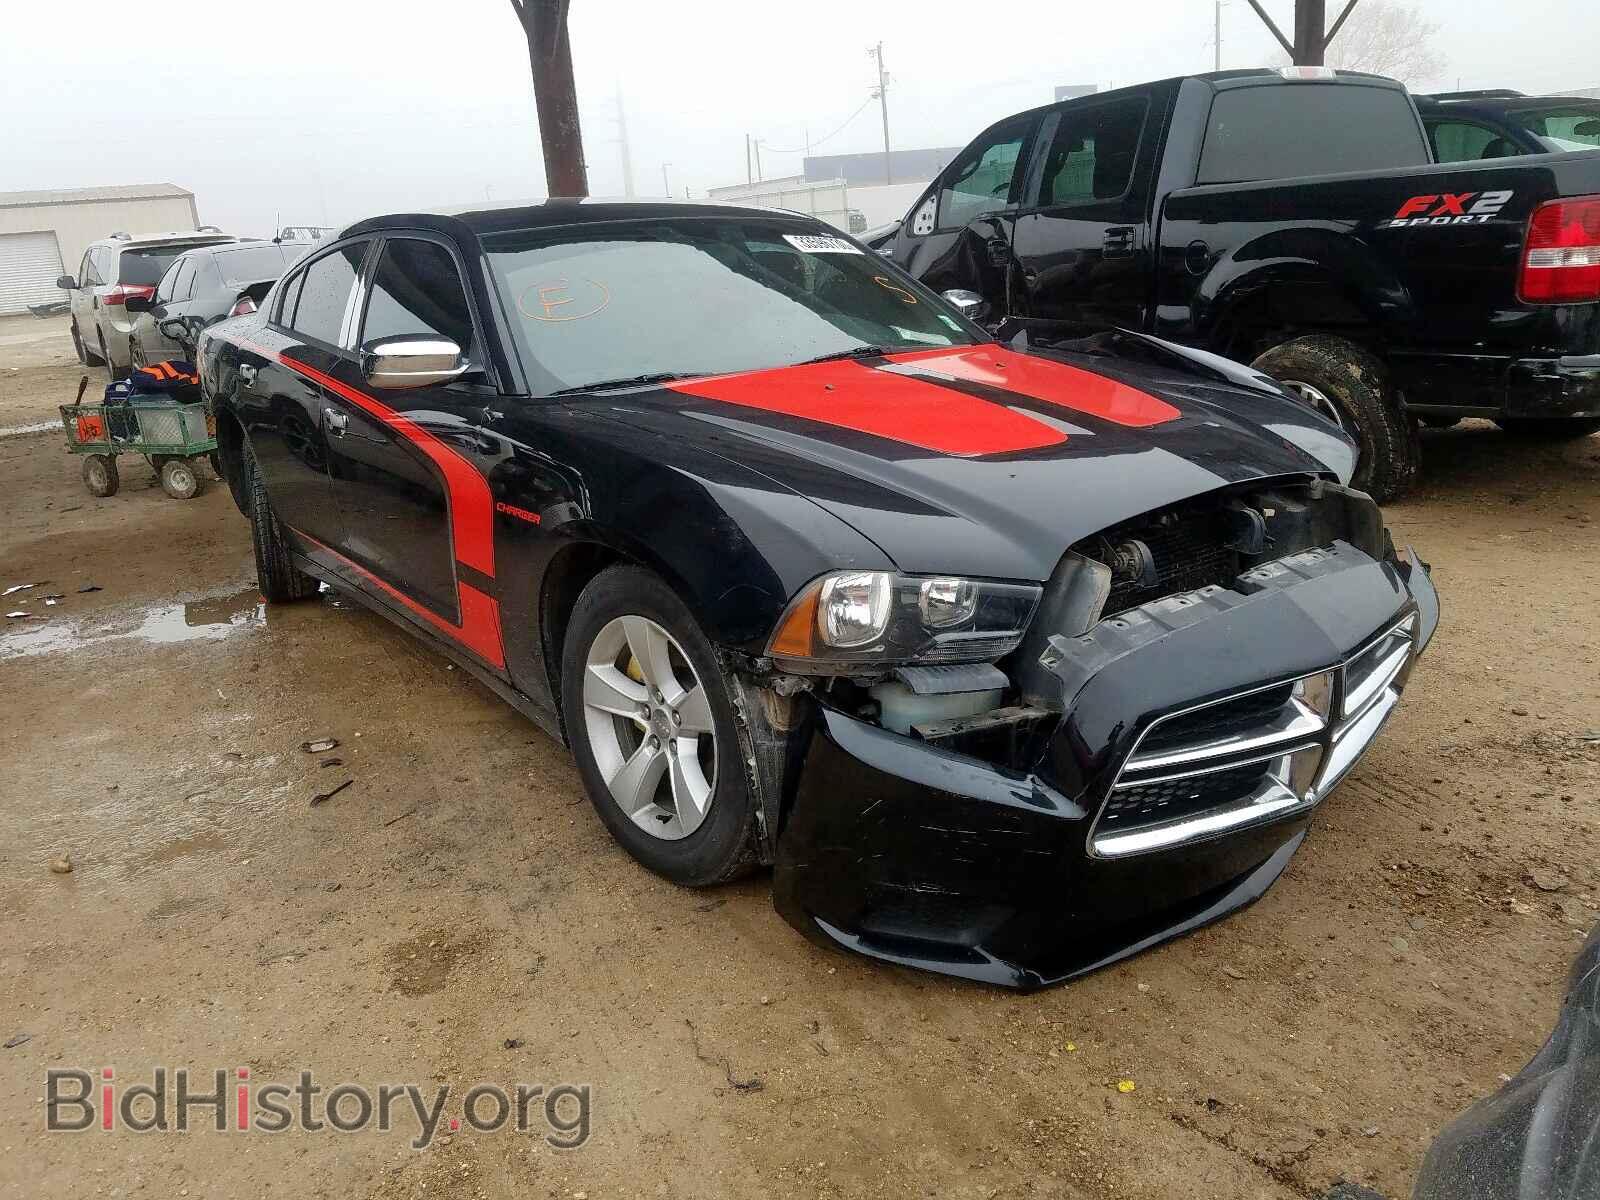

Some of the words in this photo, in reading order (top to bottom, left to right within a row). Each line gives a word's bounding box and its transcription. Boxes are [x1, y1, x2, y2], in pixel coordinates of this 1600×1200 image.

[1395, 190, 1514, 218] FX2
[1389, 213, 1497, 227] SPORT
[496, 502, 541, 525] CHARGER
